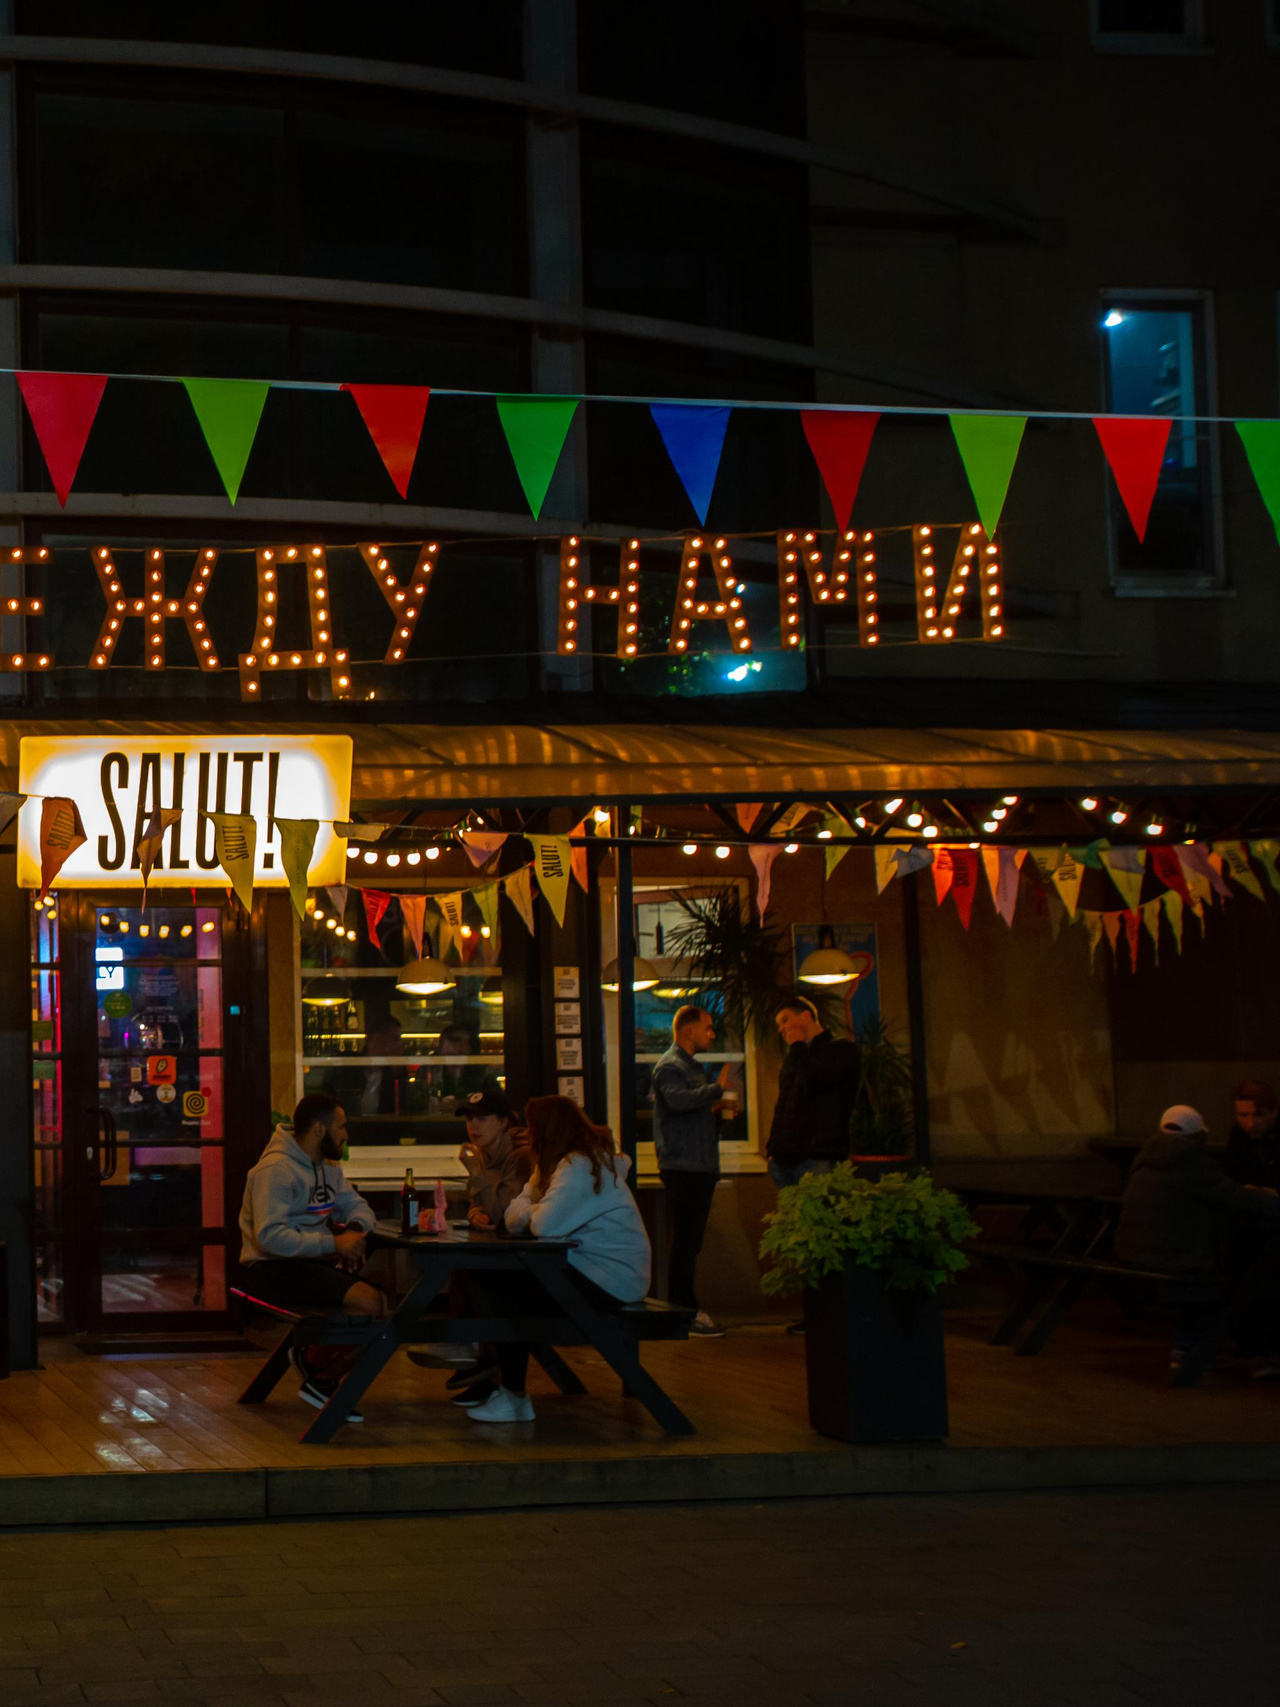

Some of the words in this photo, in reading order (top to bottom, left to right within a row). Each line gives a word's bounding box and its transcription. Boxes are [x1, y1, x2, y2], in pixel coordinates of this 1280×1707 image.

[557, 522, 1005, 658] НАМИ
[97, 751, 281, 870] SALUT!
[221, 825, 250, 861] SALUT!
[540, 844, 564, 878] SALUT!
